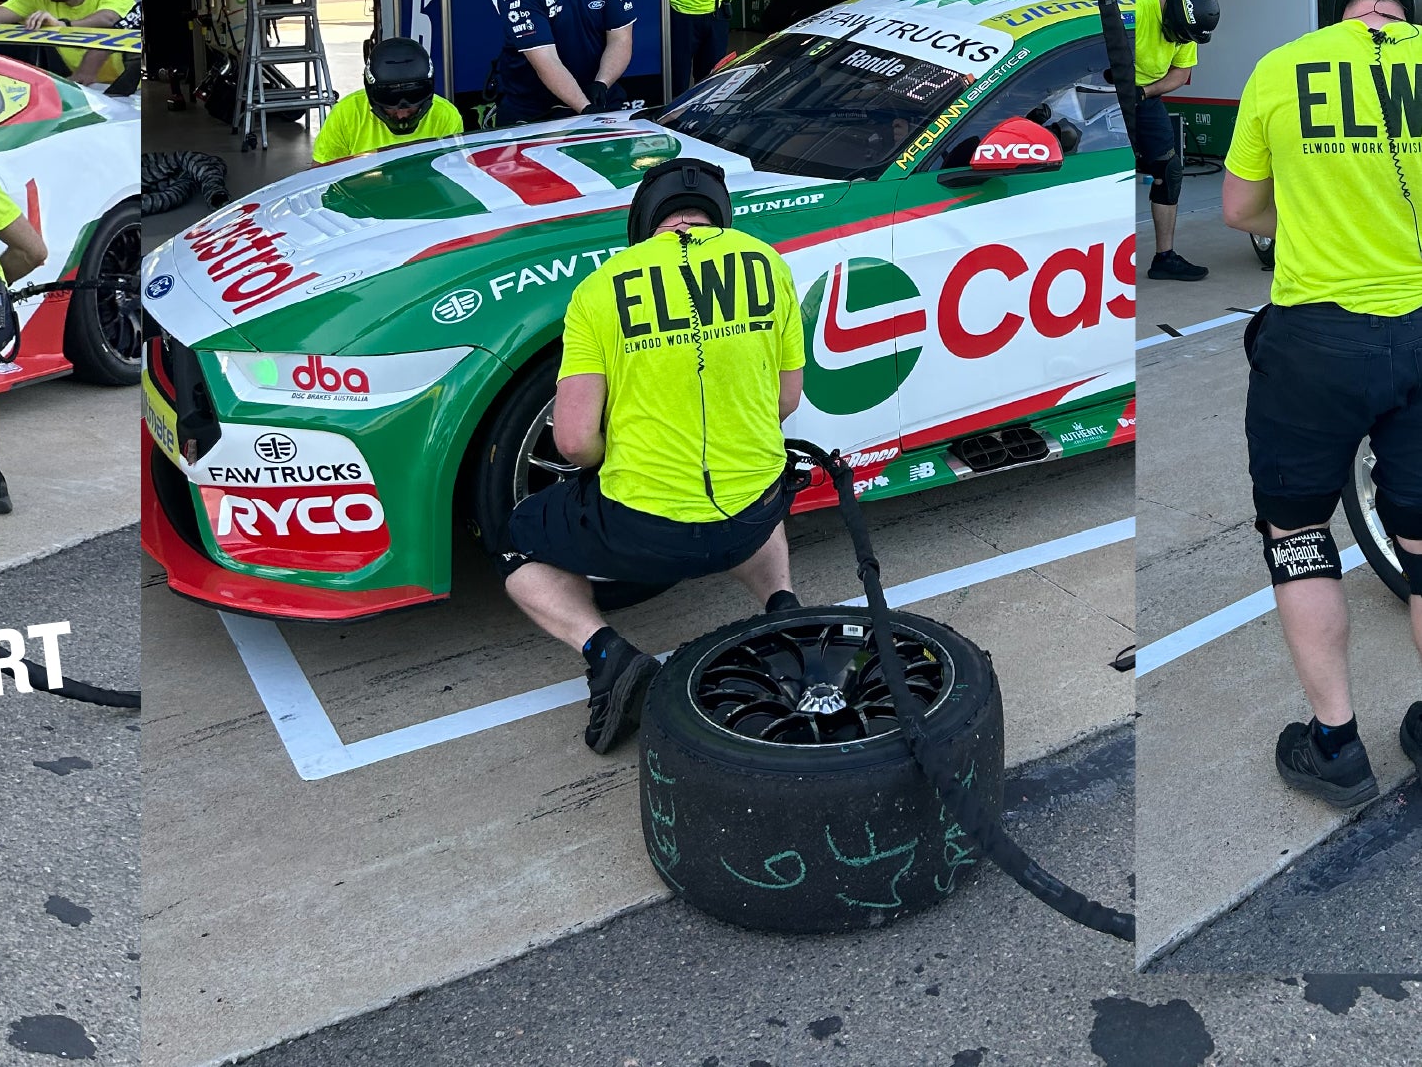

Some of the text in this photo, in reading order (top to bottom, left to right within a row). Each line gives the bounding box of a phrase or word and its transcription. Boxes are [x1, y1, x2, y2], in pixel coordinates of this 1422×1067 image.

[520, 9, 531, 19] bp
[826, 11, 1001, 64] FAW TRUCKS
[840, 49, 906, 77] Randle
[895, 46, 1031, 171] McQUINN electrical
[1195, 113, 1211, 125] ELWD
[974, 142, 1050, 161] RYCO
[1303, 142, 1384, 154] ELWOOD WORK
[733, 193, 825, 216] DUNLOP
[489, 256, 578, 301] FAW
[612, 251, 776, 338] ELWD
[625, 323, 747, 354] ELWOOD WORK DIVISION
[291, 355, 370, 394] dba
[306, 393, 332, 401] BRAKES
[333, 395, 369, 403] AUSTRALIA
[1060, 424, 1108, 444] AUTHENTIC
[851, 447, 898, 469] Repco
[208, 463, 362, 484] FAW TRUCKS
[217, 493, 385, 536] RYCO
[1272, 542, 1323, 566] Mechanix
